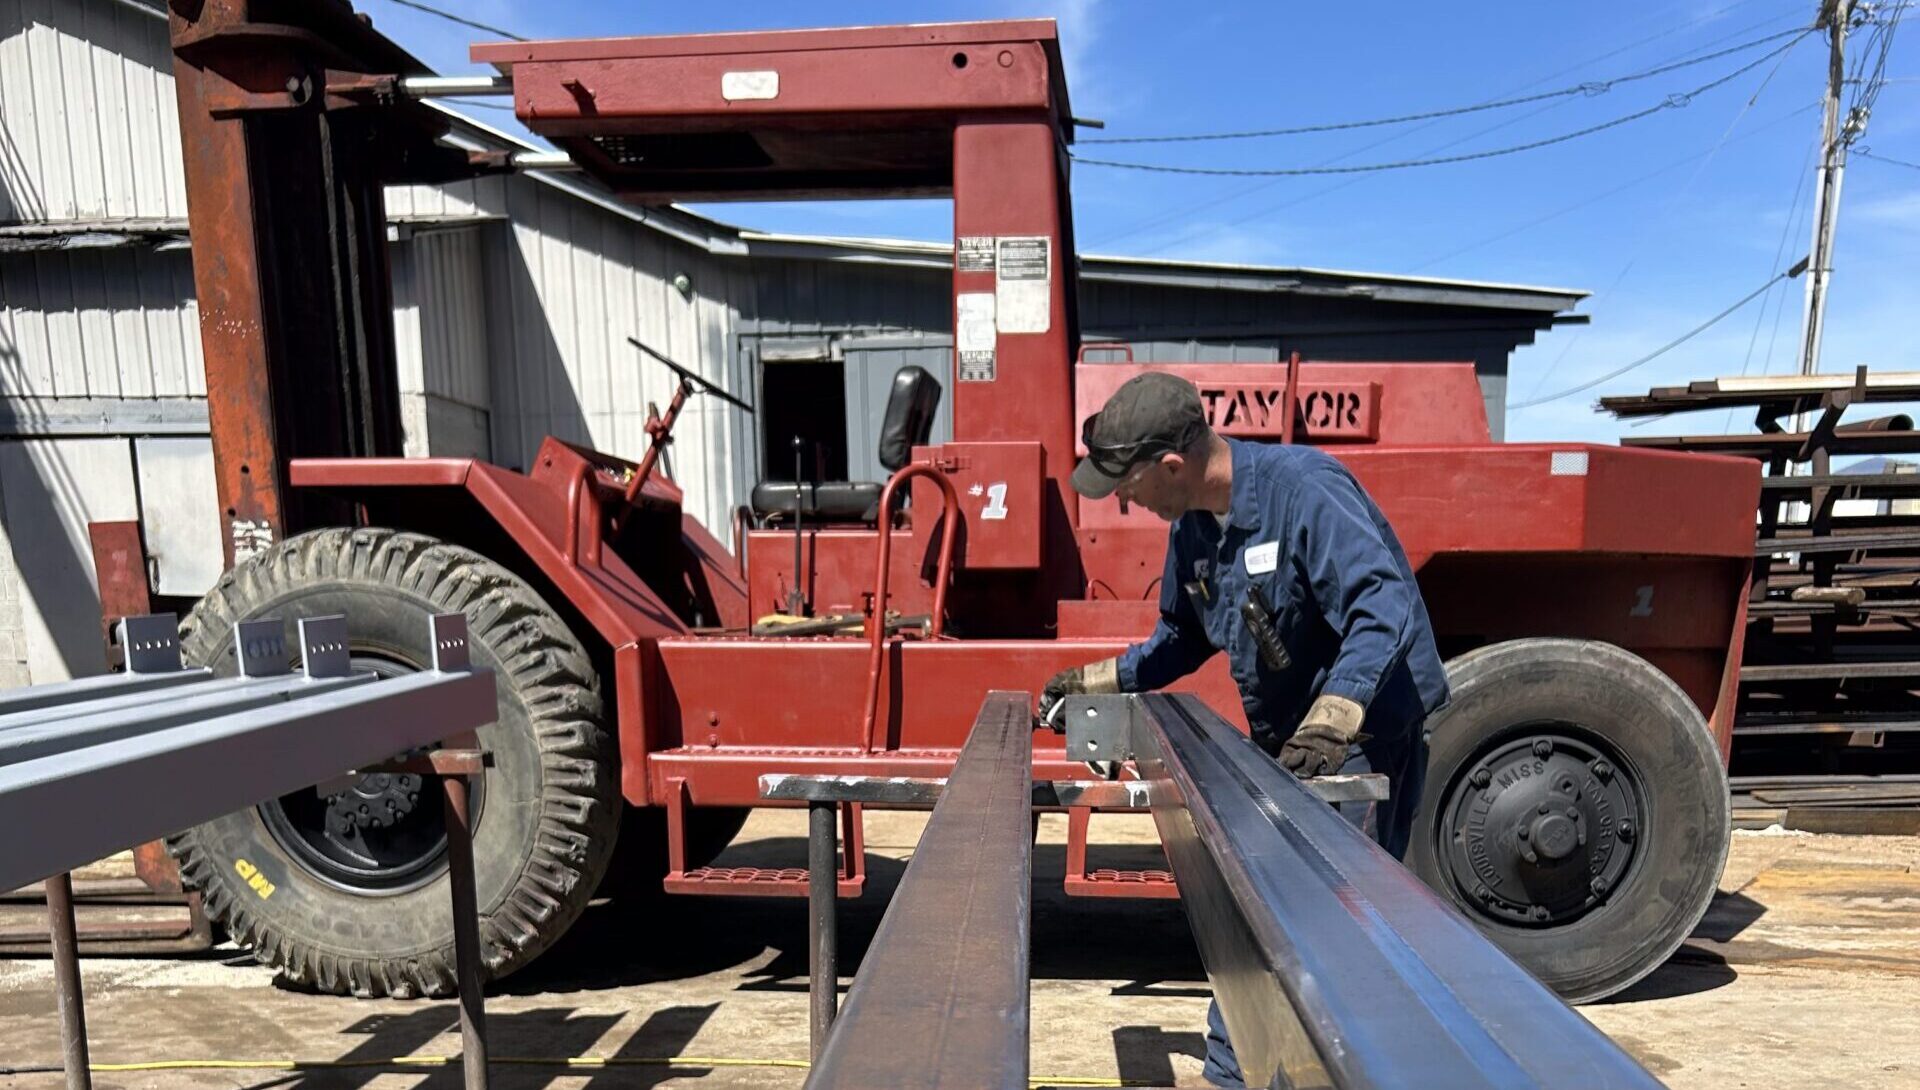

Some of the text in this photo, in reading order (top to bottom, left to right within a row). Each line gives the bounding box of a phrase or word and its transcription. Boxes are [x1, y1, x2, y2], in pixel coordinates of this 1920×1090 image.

[1201, 389, 1362, 429] TAYOR
[968, 481, 1008, 520] #1
[1630, 584, 1654, 617] 1
[1468, 760, 1545, 889] LOUISVILLE MISS
[235, 858, 276, 901] MP
